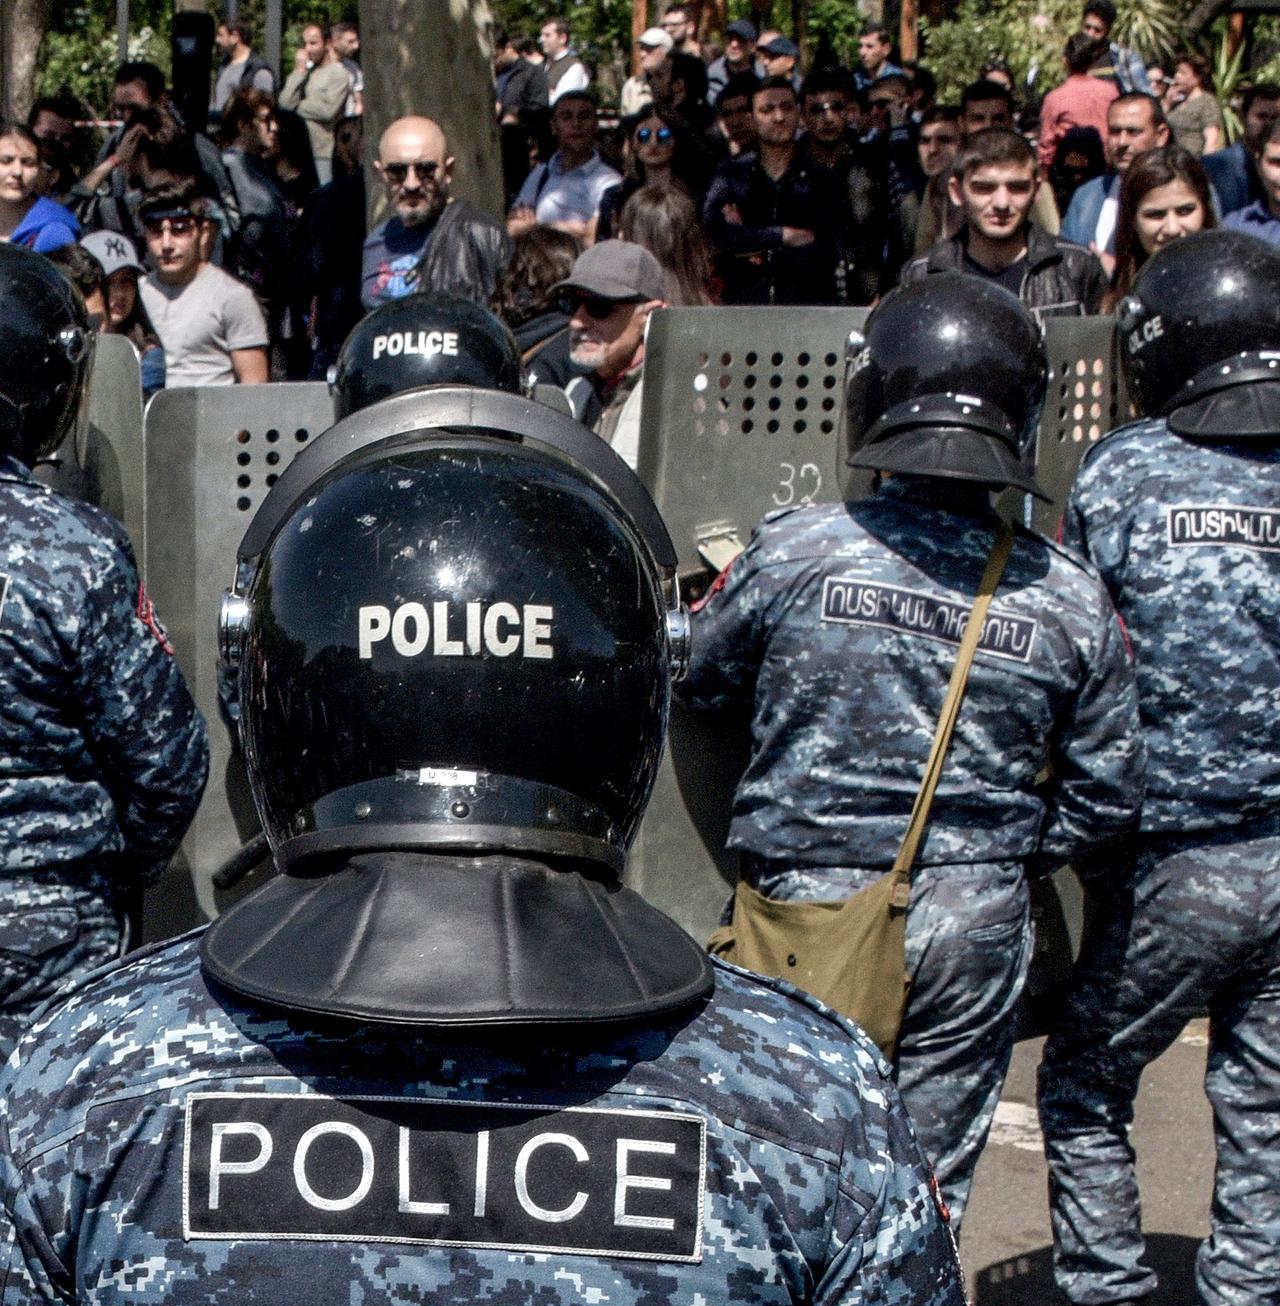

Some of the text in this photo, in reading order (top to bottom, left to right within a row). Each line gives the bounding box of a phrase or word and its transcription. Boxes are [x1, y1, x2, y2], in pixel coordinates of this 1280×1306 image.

[372, 331, 459, 360] POLICE
[358, 601, 554, 659] POLICE
[829, 585, 1027, 651] ՈՍՏԻԿԱՆՈՒԹՈՒՆ
[208, 1121, 676, 1231] POLICE
